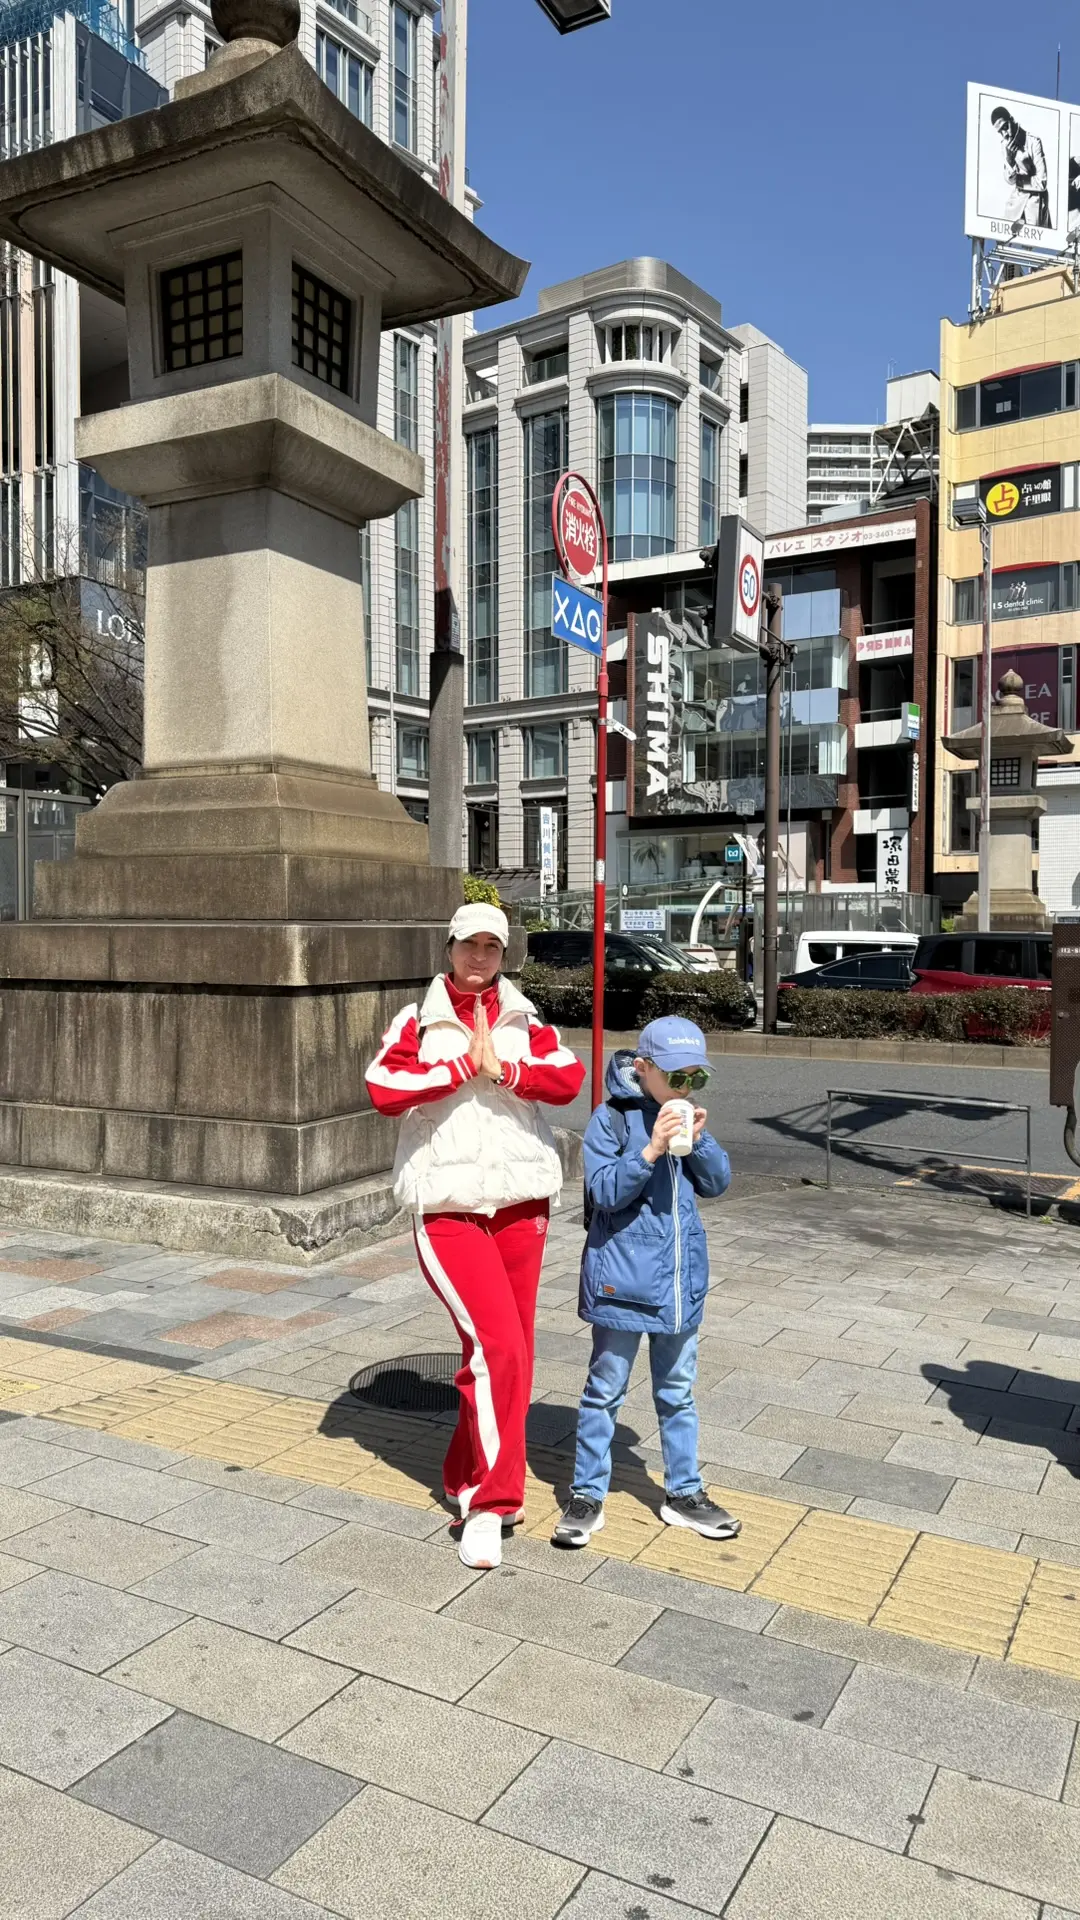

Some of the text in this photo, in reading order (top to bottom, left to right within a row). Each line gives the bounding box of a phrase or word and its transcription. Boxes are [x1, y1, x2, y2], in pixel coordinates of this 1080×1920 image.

[990, 221, 1044, 241] BURERRY
[994, 484, 1016, 513] 占
[565, 509, 596, 557] 消火栓
[744, 569, 755, 601] 50
[1003, 599, 1025, 609] dental
[1025, 596, 1044, 606] clinic
[646, 632, 669, 797] SHIMA
